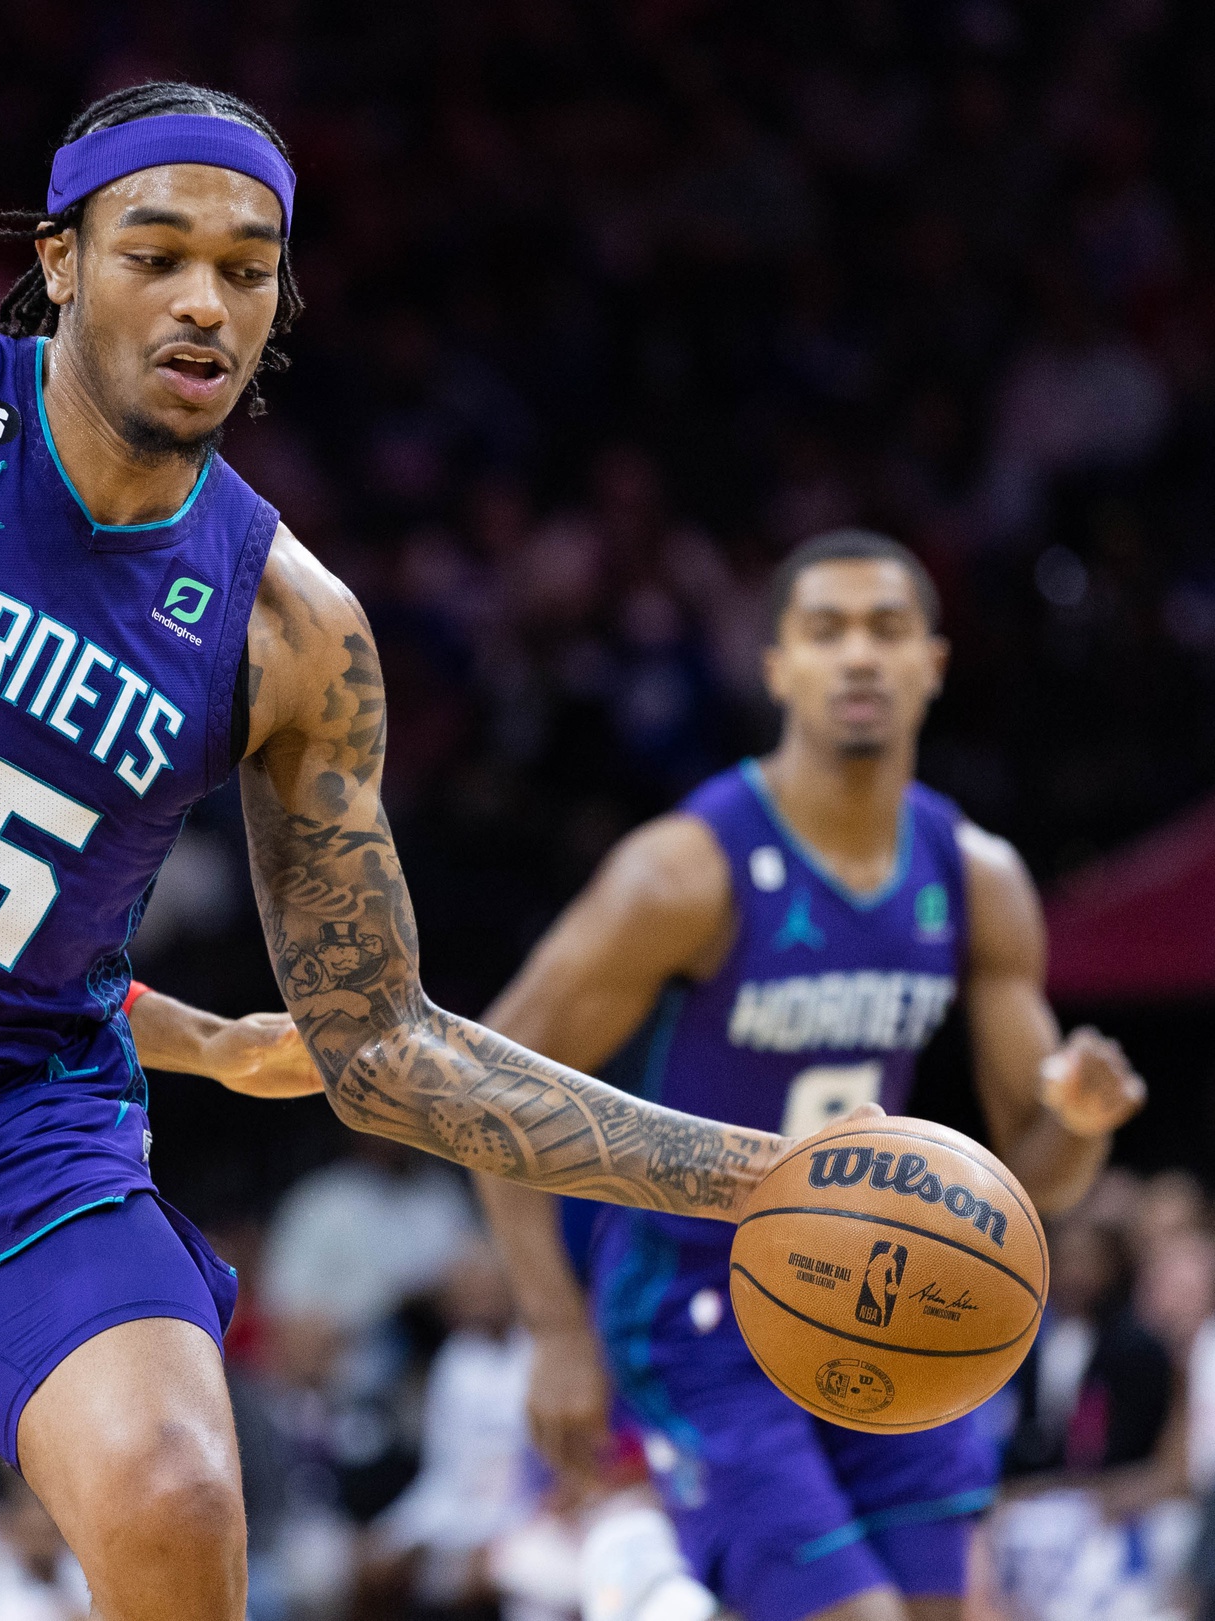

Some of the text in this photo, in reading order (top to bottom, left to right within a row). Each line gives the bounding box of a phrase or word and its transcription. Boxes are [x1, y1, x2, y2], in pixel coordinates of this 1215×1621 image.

[151, 607, 203, 647] lendingtree
[808, 1147, 1008, 1248] Wilson
[788, 1252, 851, 1282] OFFICIAL GAME BALL
[859, 1305, 878, 1322] NBA
